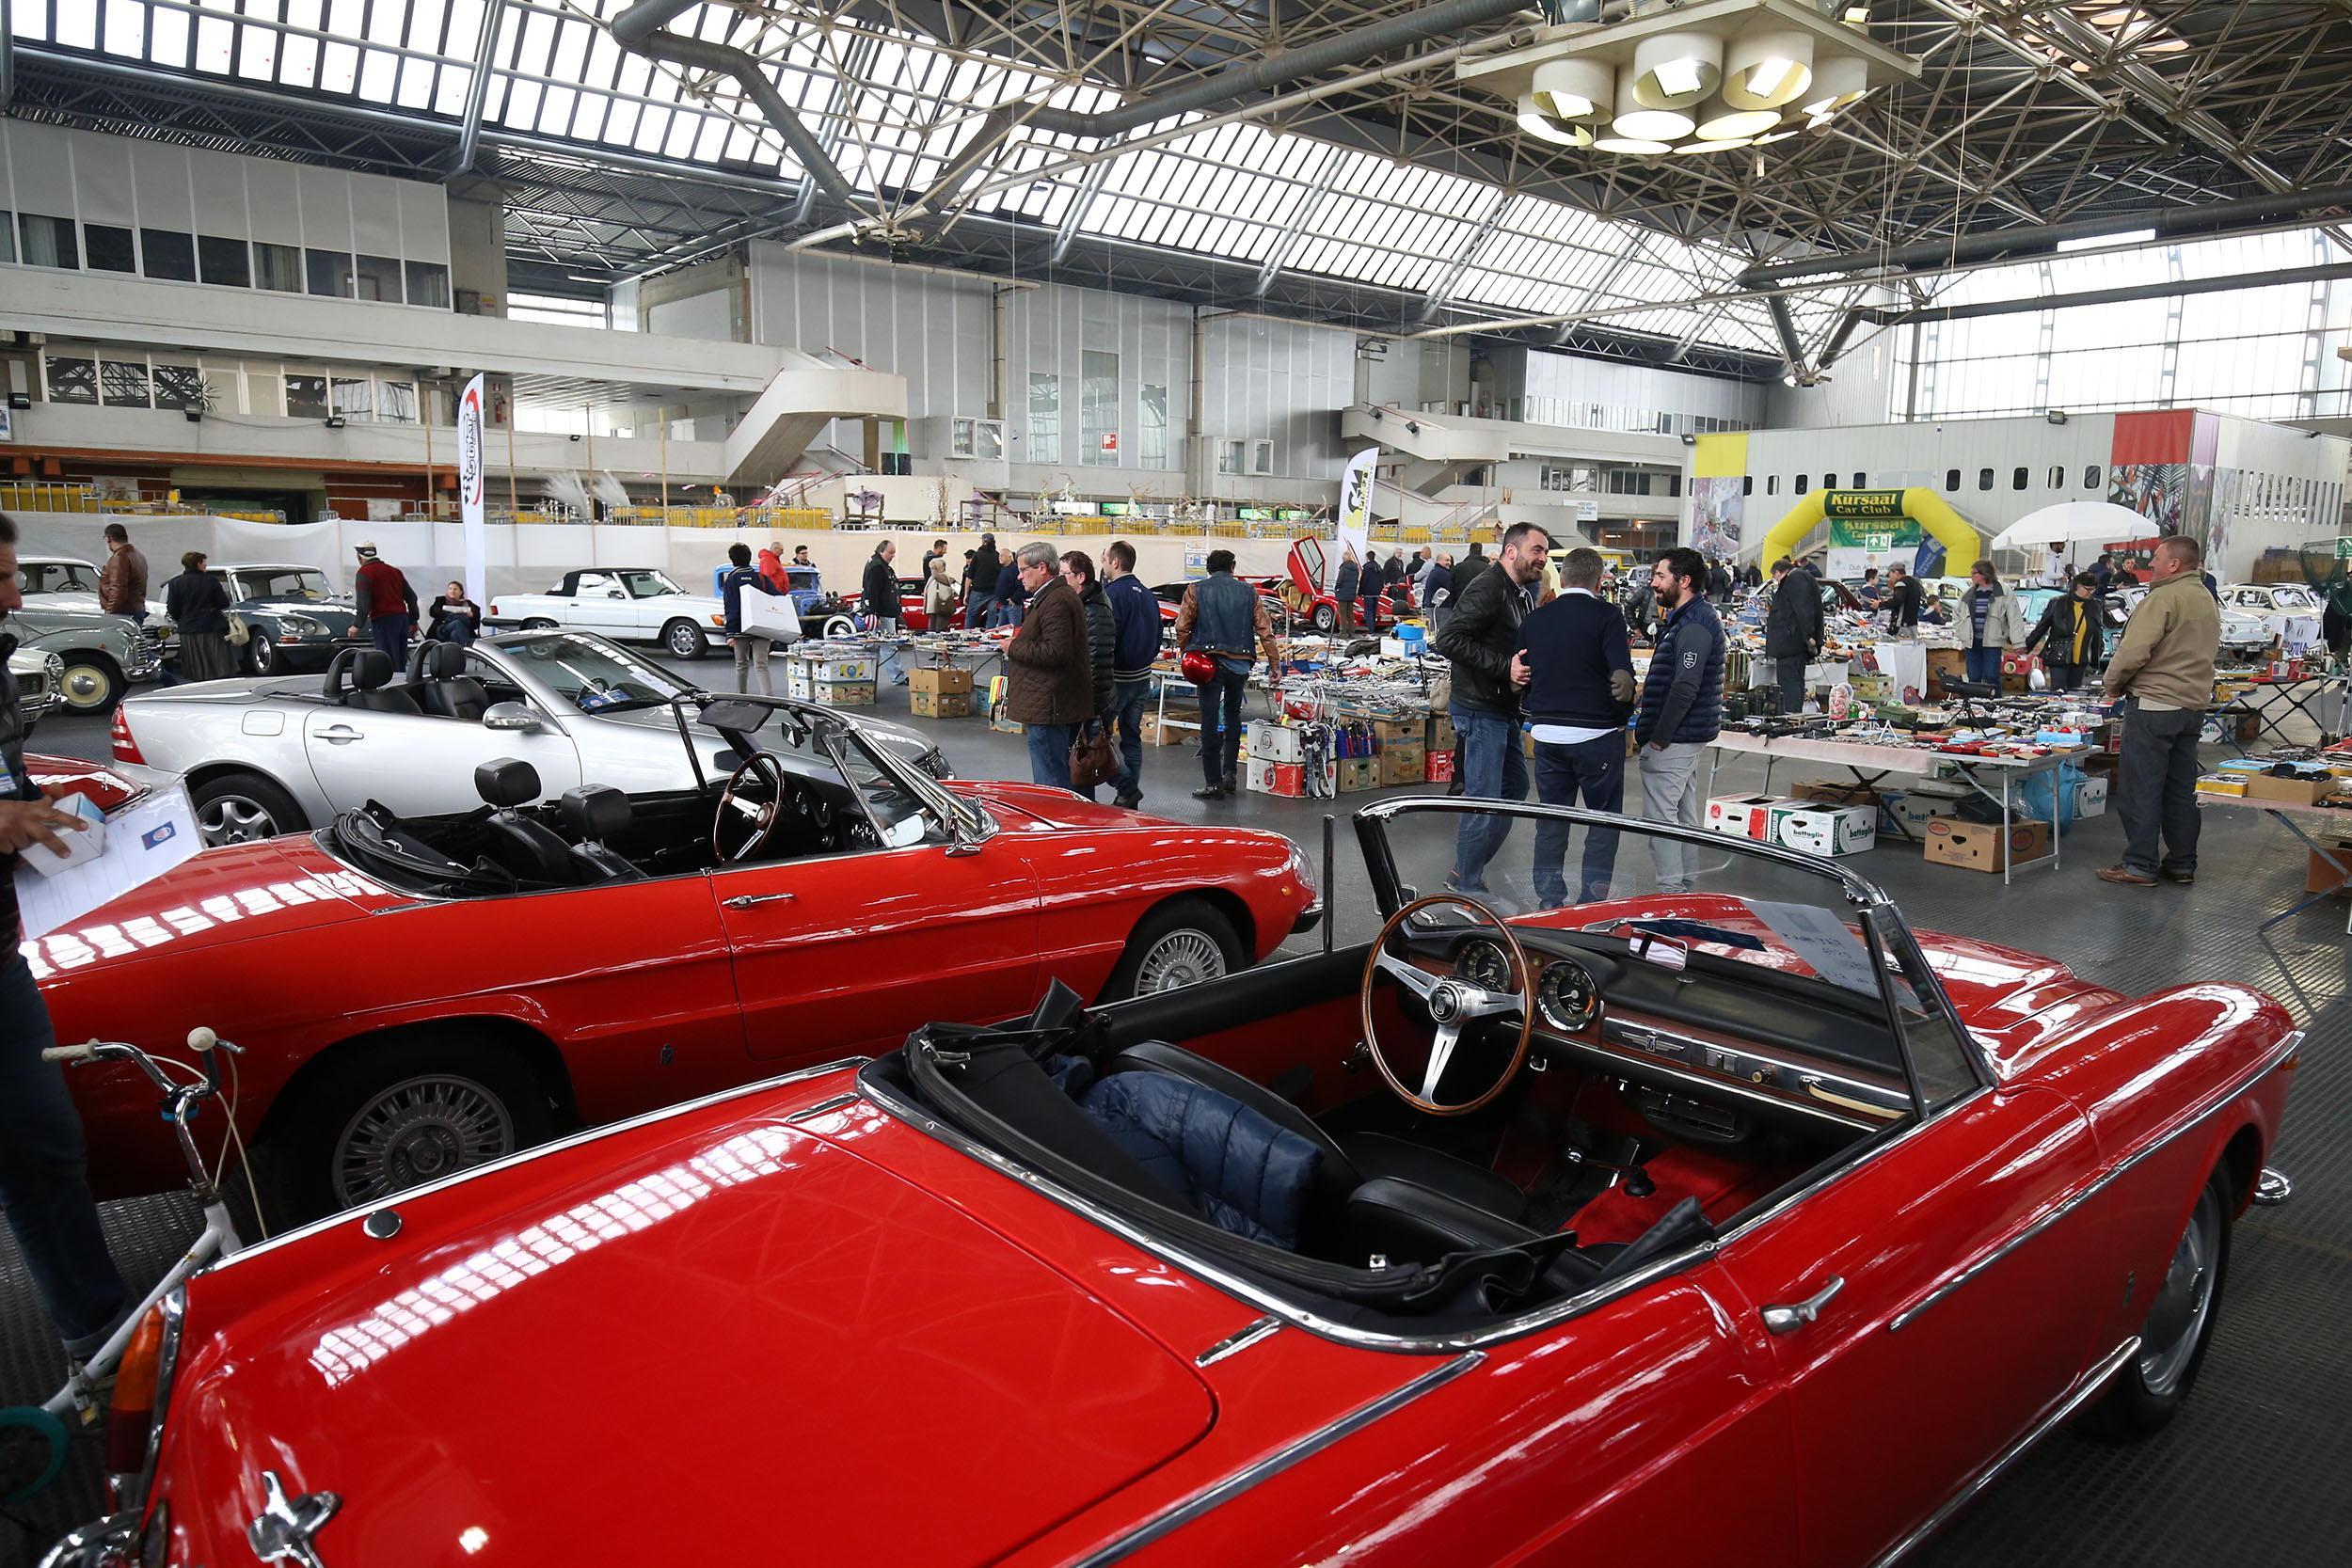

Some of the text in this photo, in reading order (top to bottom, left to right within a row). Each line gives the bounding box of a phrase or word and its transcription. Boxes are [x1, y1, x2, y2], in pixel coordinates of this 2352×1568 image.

[1831, 494, 1897, 505] Kursaal
[1836, 505, 1891, 514] Car Club
[1793, 829, 1824, 839] battaglio
